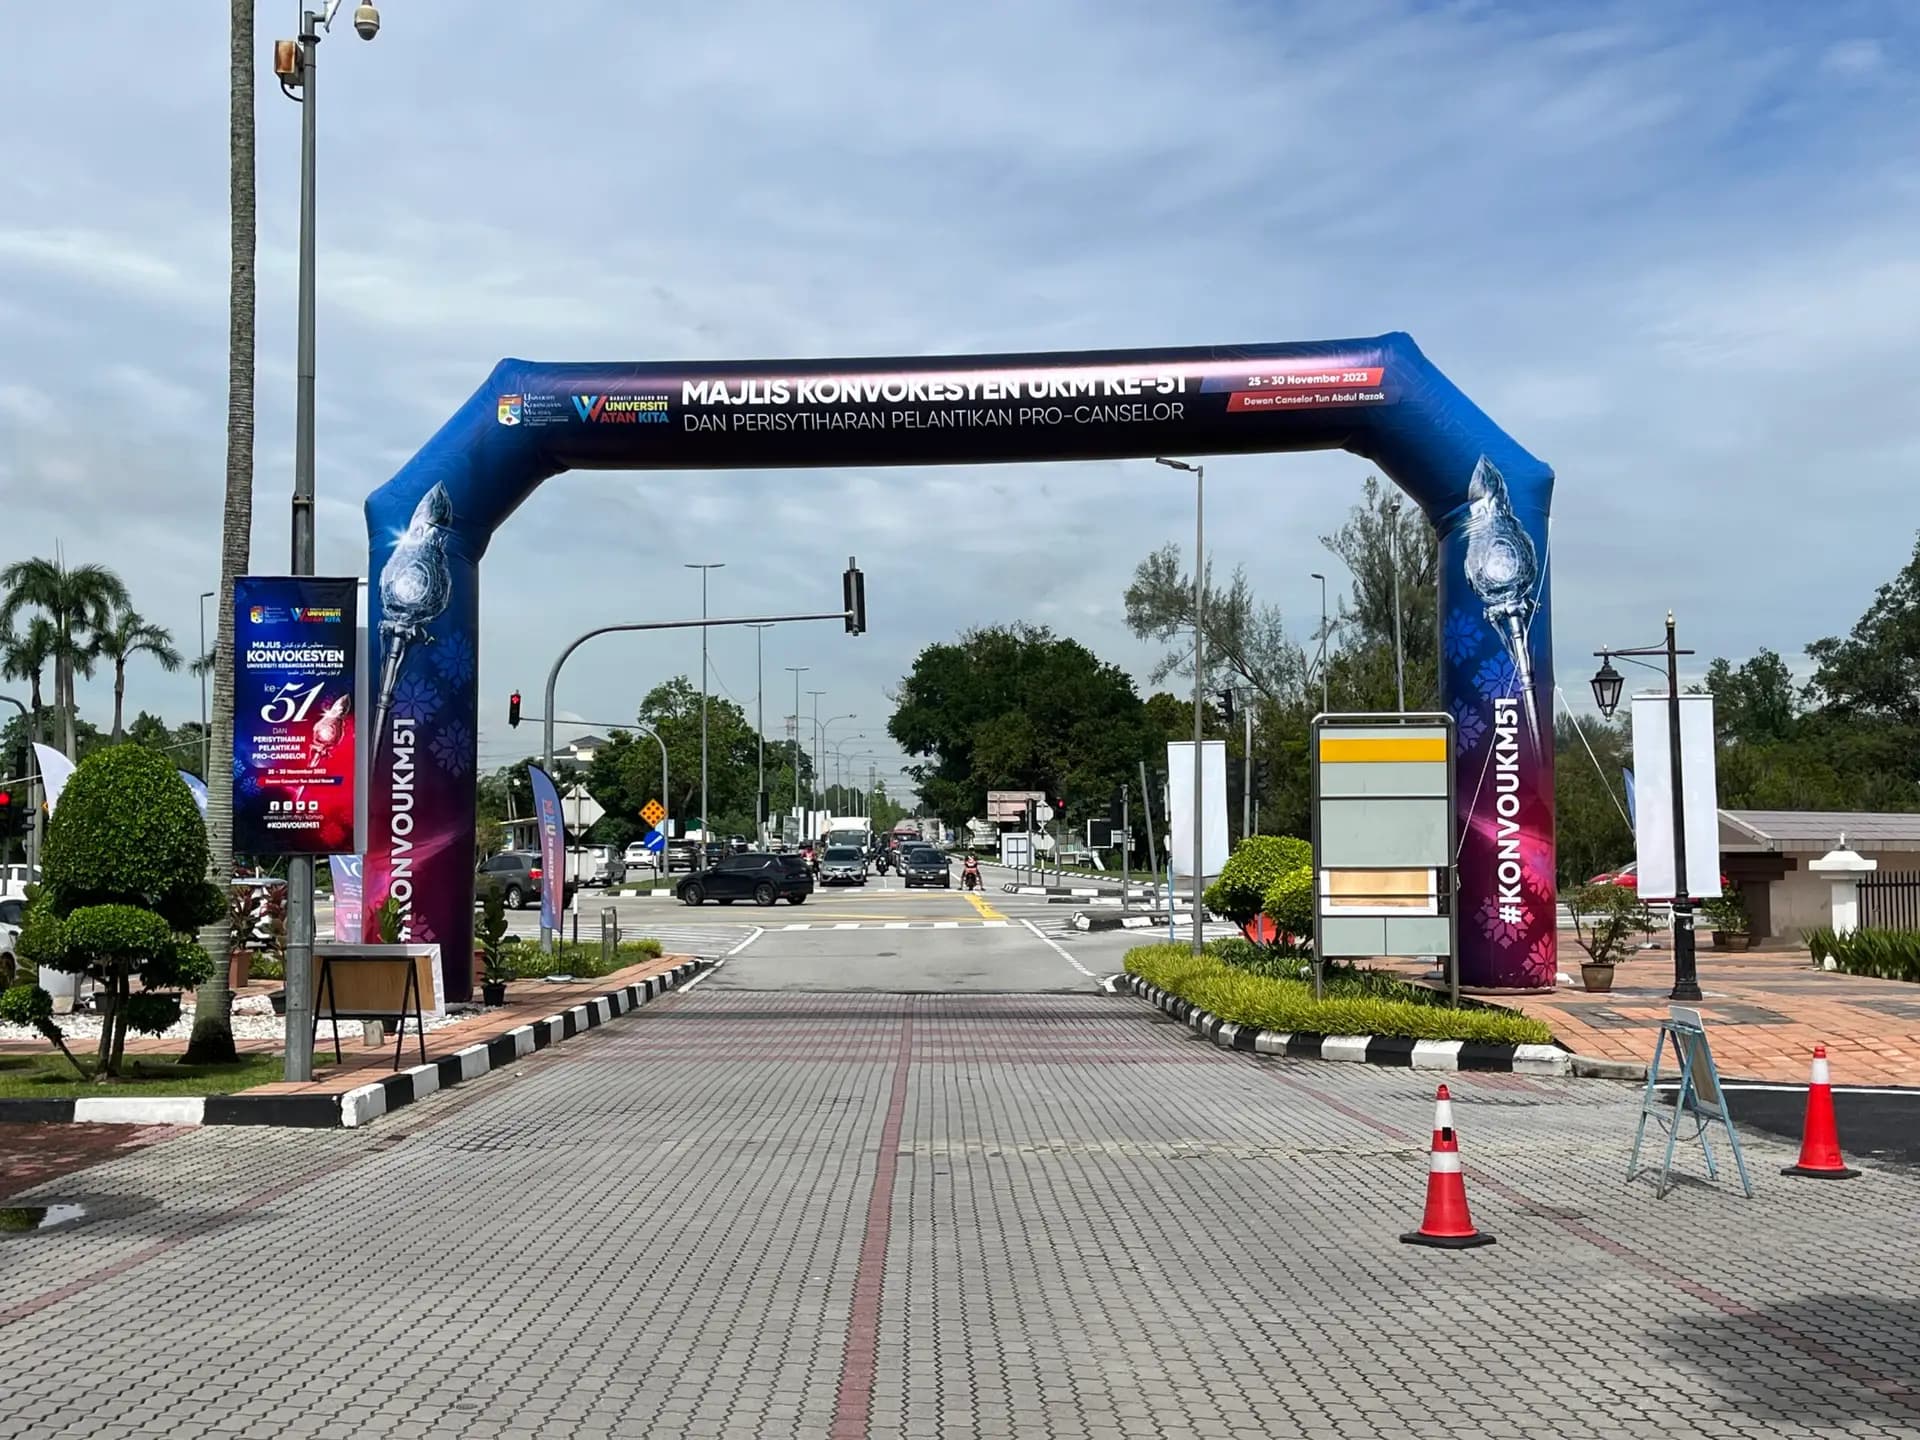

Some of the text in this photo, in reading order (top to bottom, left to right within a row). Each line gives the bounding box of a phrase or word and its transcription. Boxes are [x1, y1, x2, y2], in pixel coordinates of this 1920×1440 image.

[1248, 376, 1261, 386] 25
[1271, 375, 1285, 385] 30
[1287, 373, 1340, 385] November
[1343, 372, 1368, 383] 2023
[681, 370, 1186, 405] MAJLIS KONVOKESYEN UKM KE-51
[1243, 391, 1385, 406] Dewan Canselor Tun Abdul Razak
[605, 401, 668, 411] UNIVERSITI
[638, 412, 670, 423] KITA
[683, 402, 1185, 432] DAN PERISYTIHARAN PELANTIKAN PRO-CANSELOR
[252, 641, 281, 649] MAJLIS
[246, 650, 344, 662] KONVOKESYEN
[261, 681, 325, 724] ke- 51
[272, 727, 288, 735] DAN
[253, 735, 306, 743] PERISYTIHARAN
[258, 744, 301, 752] PELANTIKAN
[252, 752, 307, 760] PRO-CANSELOR
[1495, 698, 1522, 925] #KONVOUKM51
